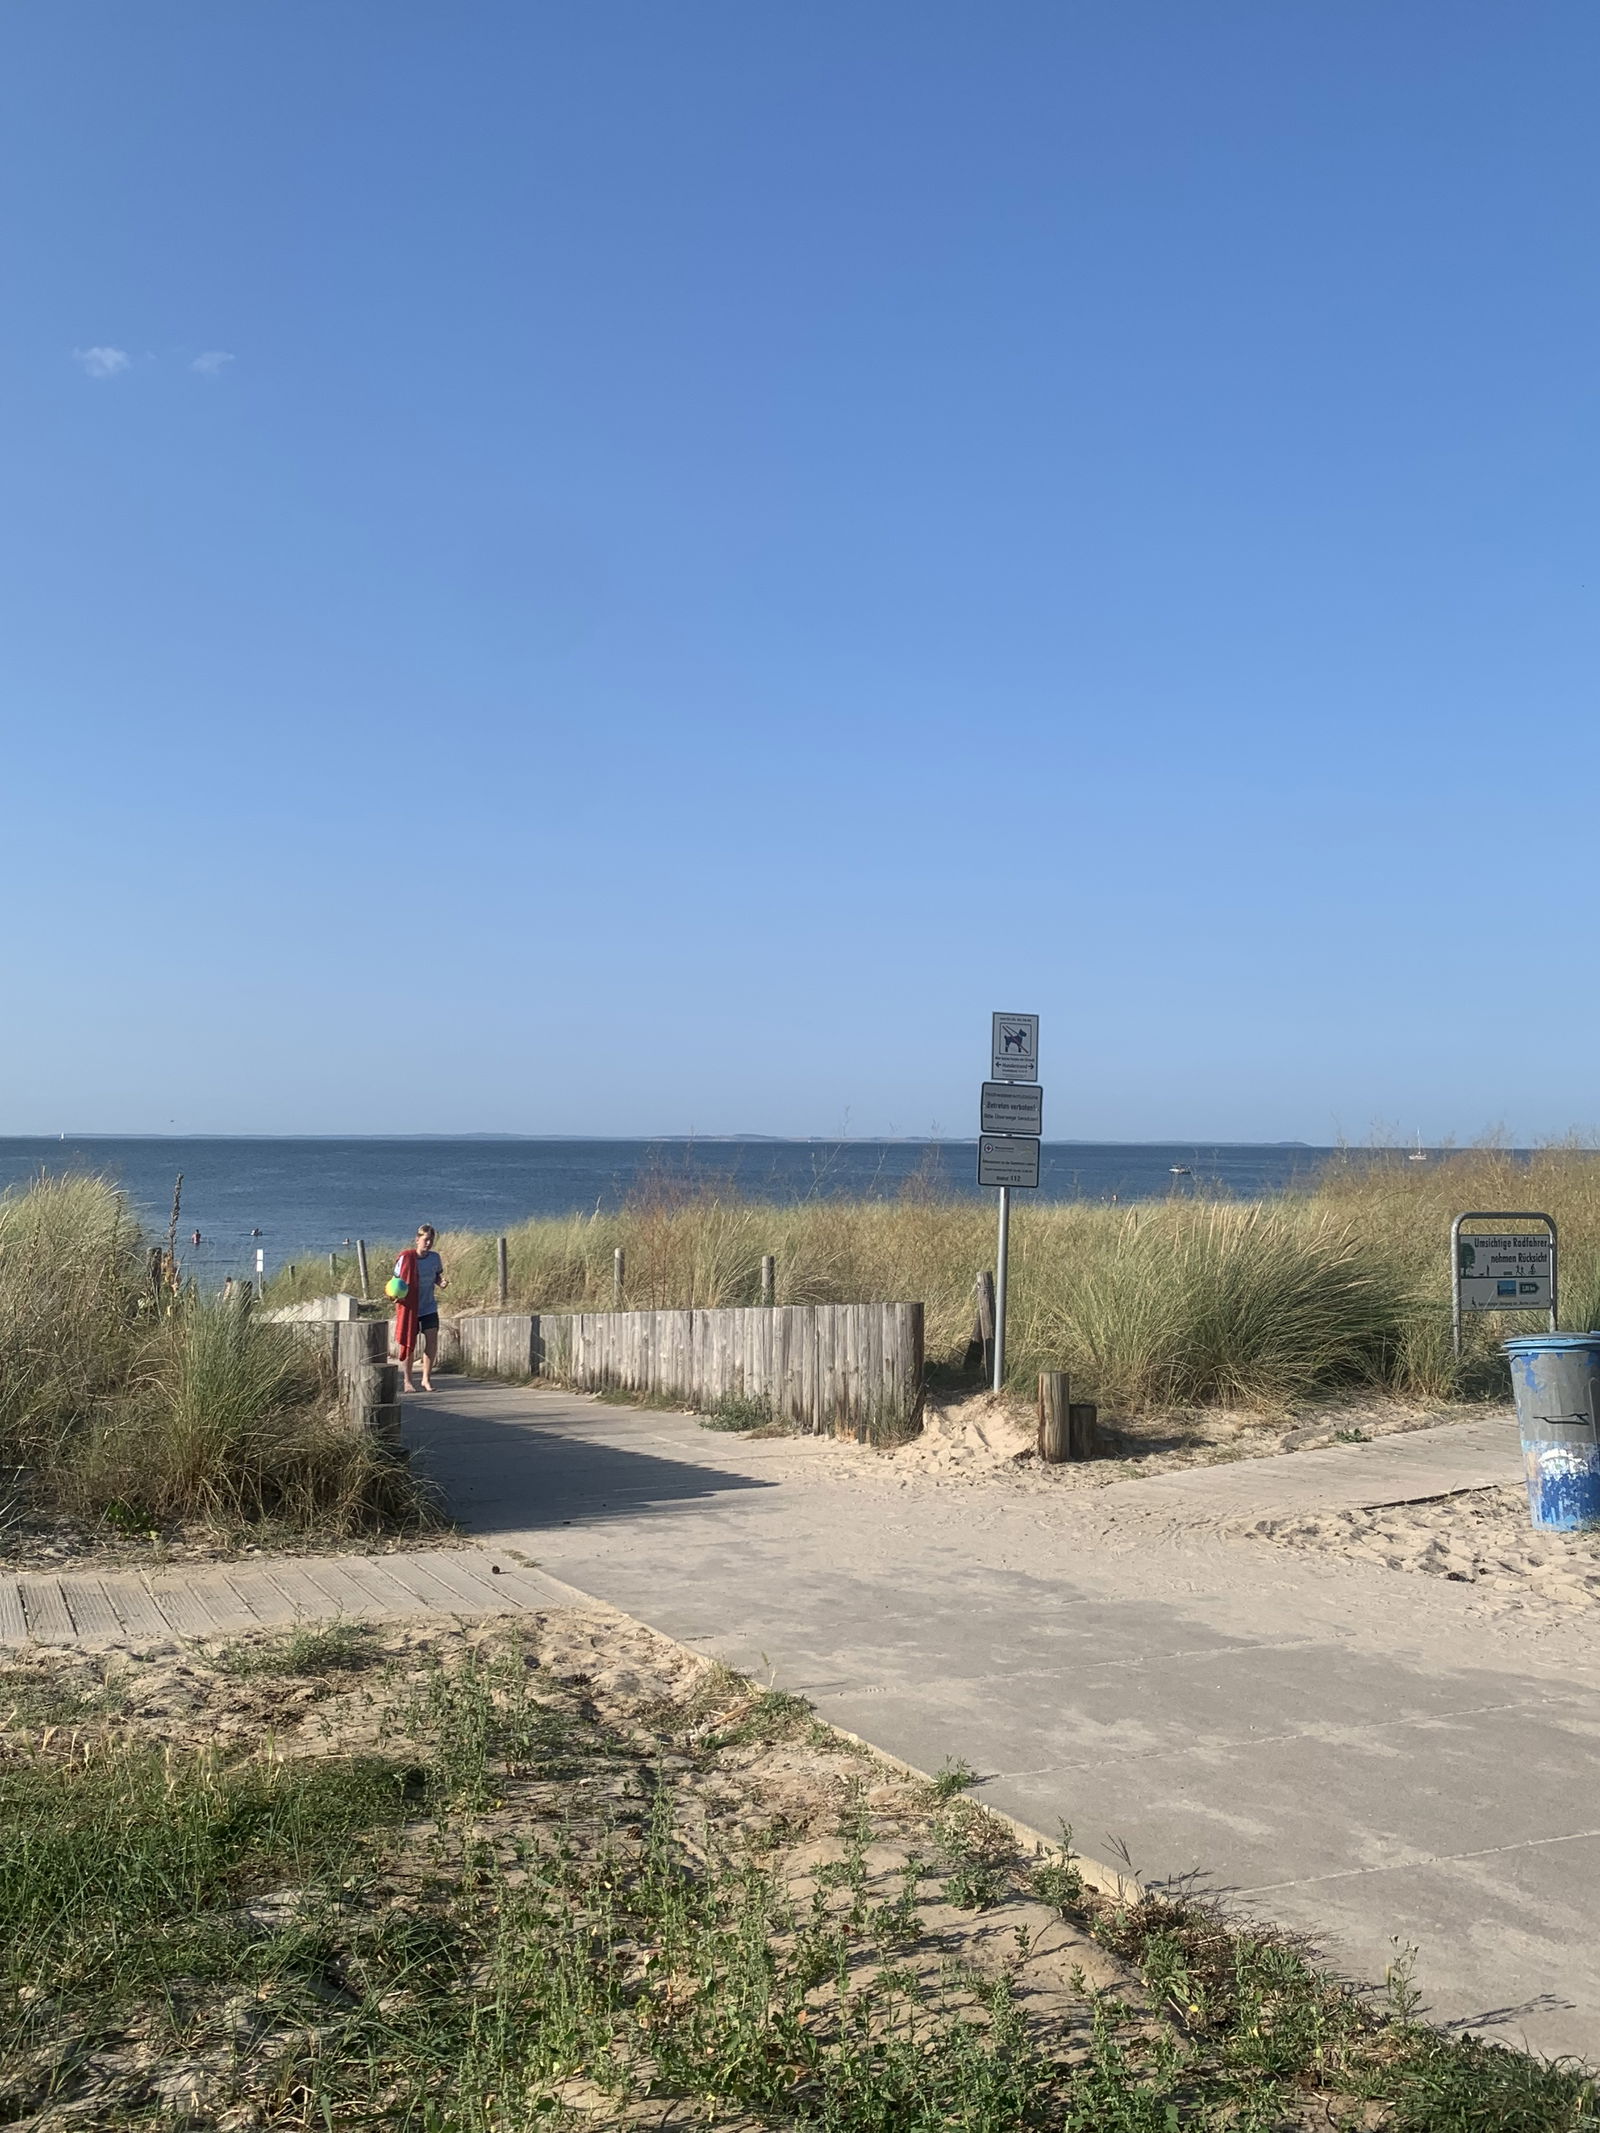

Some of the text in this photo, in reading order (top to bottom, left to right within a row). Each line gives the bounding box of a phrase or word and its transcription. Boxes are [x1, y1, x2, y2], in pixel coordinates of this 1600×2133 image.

[1474, 1237, 1547, 1250] Umsichtige Radfahrer
[1491, 1252, 1547, 1263] nehmen Rücksicht
